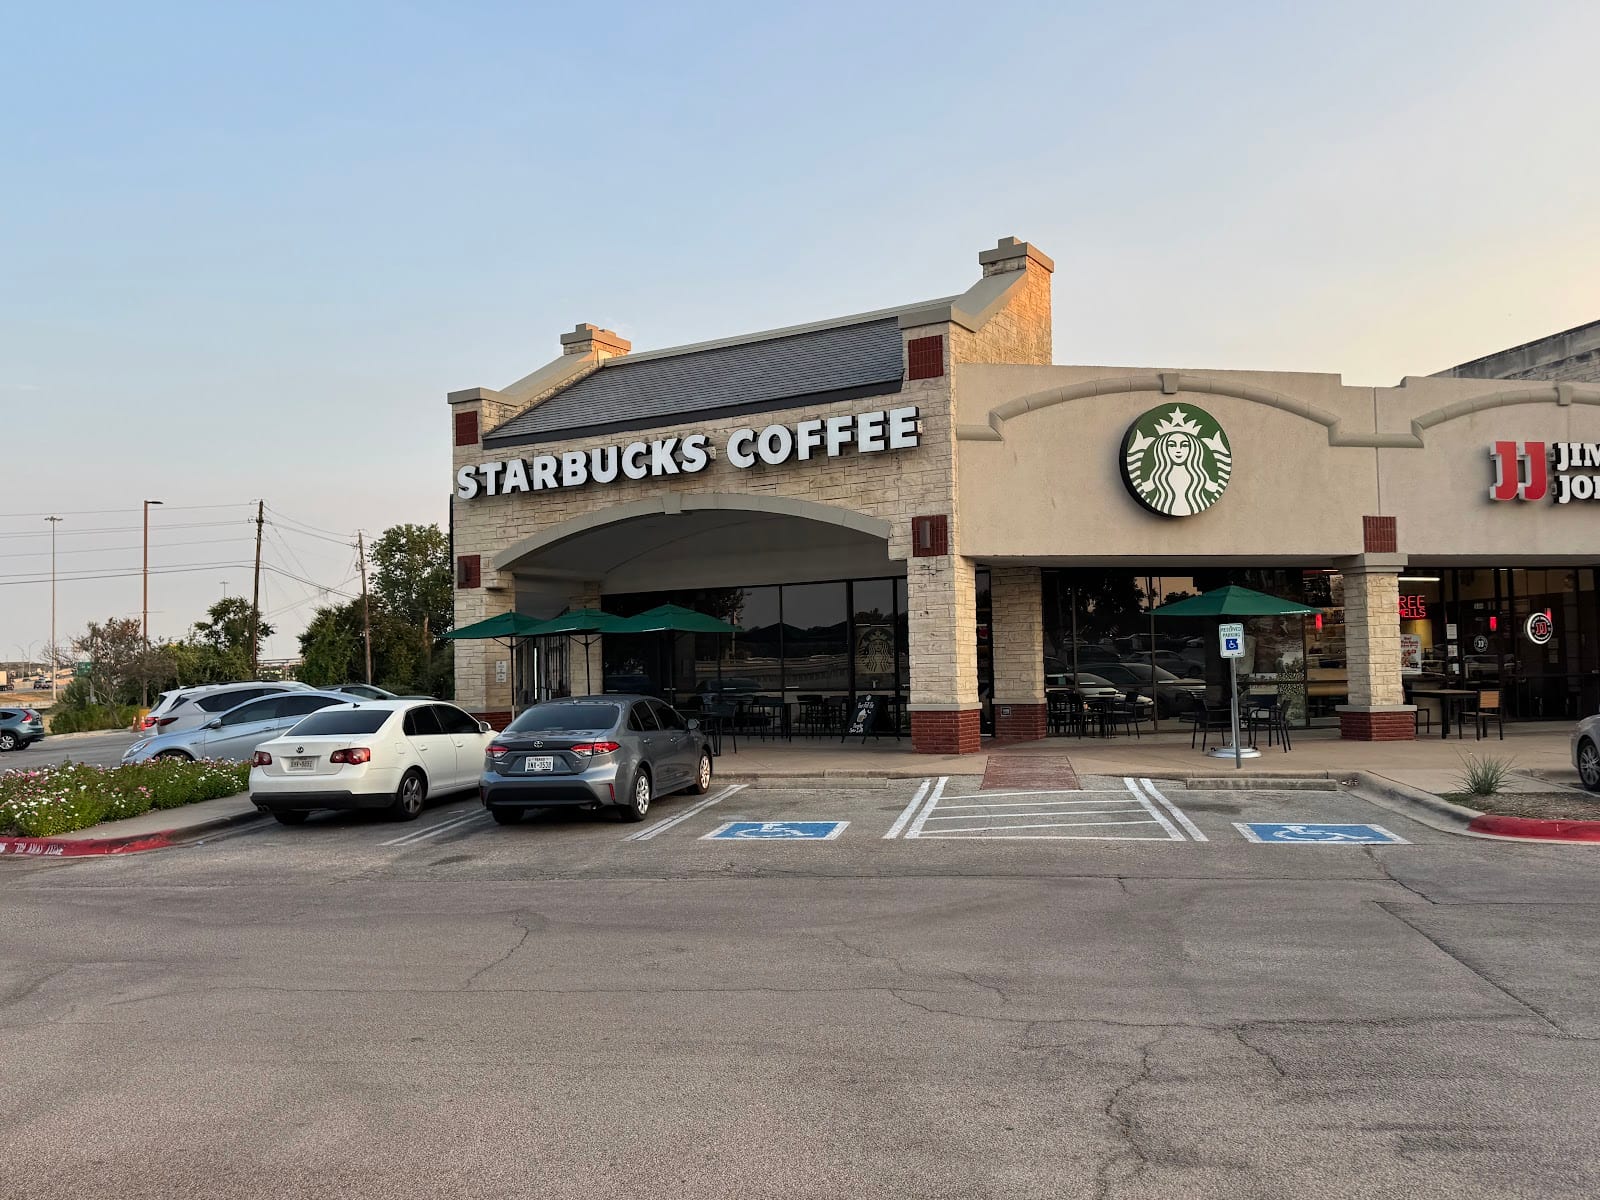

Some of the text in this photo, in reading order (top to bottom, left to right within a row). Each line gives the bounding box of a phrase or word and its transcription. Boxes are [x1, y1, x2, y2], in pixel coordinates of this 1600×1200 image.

[456, 406, 919, 500] STARBUCKS COFFEE
[1492, 440, 1547, 501] JJ
[1399, 595, 1425, 608] REE
